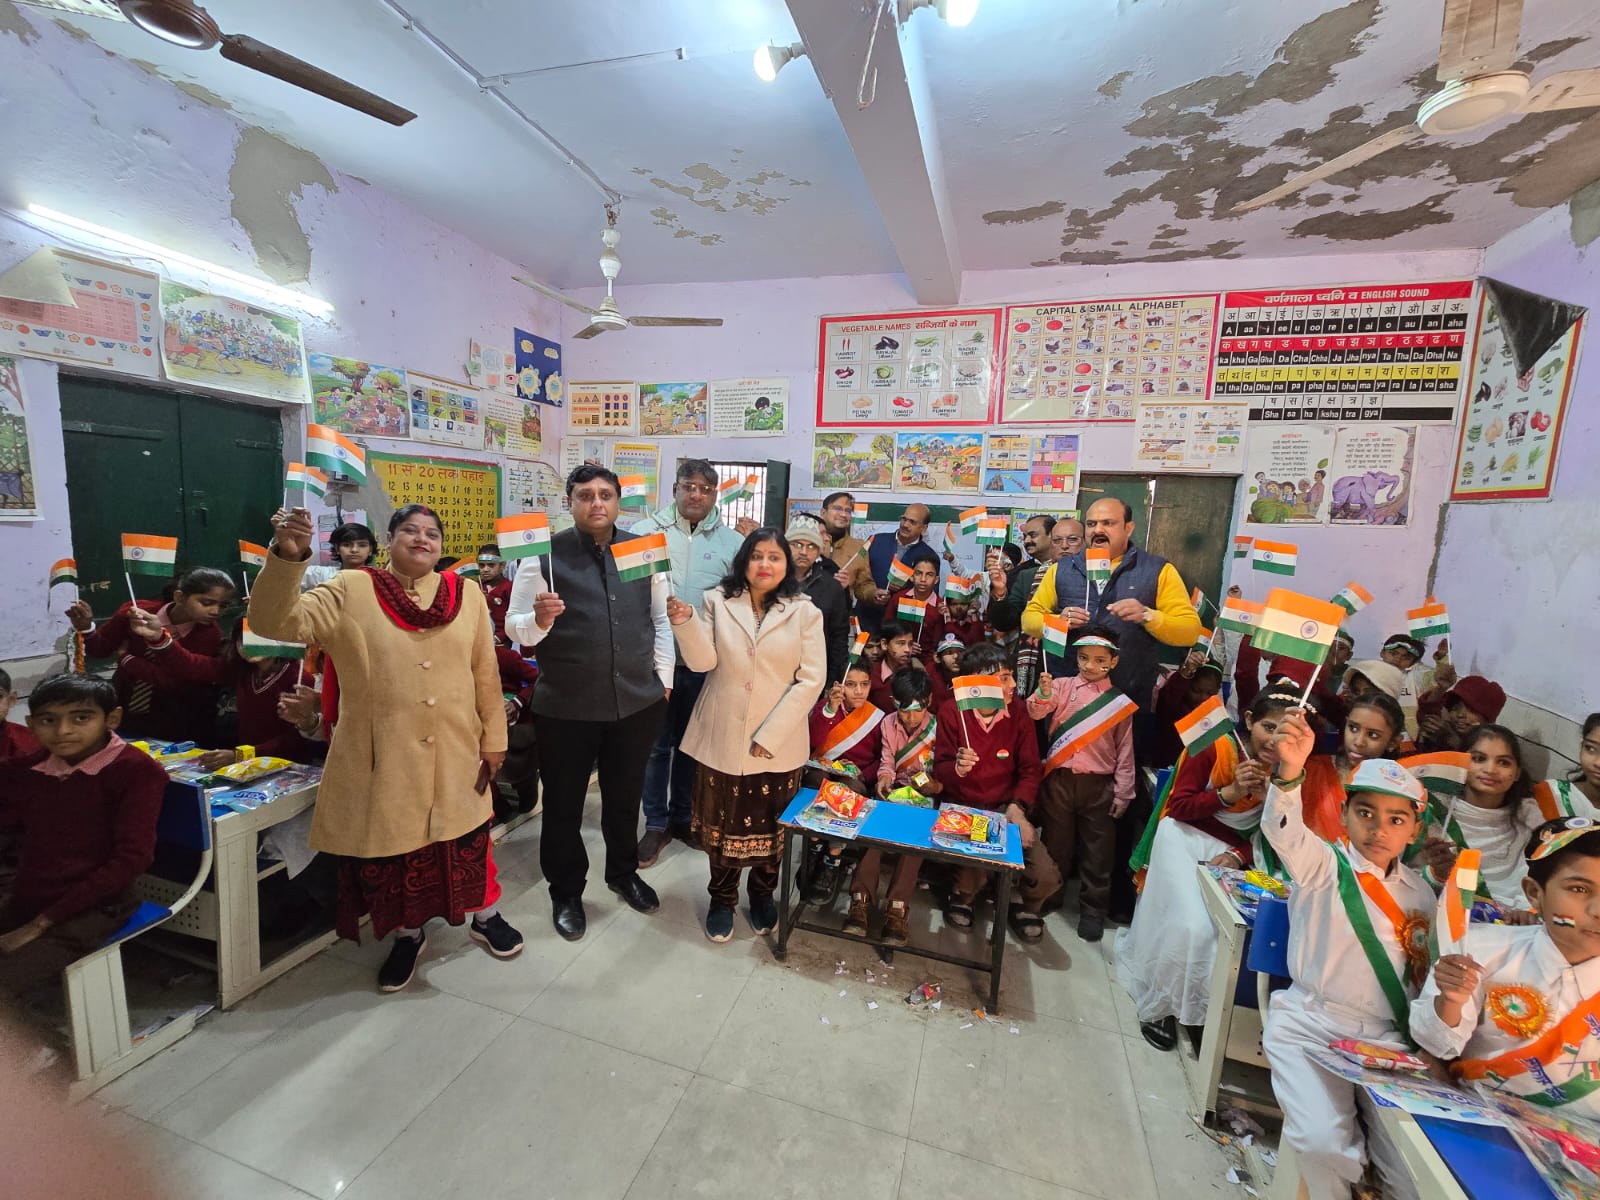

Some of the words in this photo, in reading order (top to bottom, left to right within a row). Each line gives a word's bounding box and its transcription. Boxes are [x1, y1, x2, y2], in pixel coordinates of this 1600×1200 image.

[1264, 292, 1313, 304] वर्णमाला
[1316, 290, 1346, 302] ध्वनि
[1361, 290, 1397, 299] ENGLISH
[1400, 288, 1430, 298] SOUND
[1036, 307, 1077, 316] CAPITAL
[1089, 304, 1123, 313] SMALL
[1128, 300, 1186, 310] ALPHABET
[1228, 312, 1236, 320] अ
[1244, 312, 1256, 320] आ
[1264, 312, 1272, 320] इ
[1279, 308, 1287, 320] ई
[1295, 310, 1304, 318] उ
[1350, 308, 1358, 318] ए
[1365, 304, 1373, 318] ऐ
[1384, 303, 1396, 315] ओ
[841, 324, 884, 333] VEGETABLE
[885, 322, 911, 331] NAMES
[949, 320, 958, 328] के
[1226, 326, 1232, 334] A
[1448, 319, 1463, 328] aha
[1222, 342, 1231, 350] क
[1237, 340, 1247, 349] ख
[1250, 340, 1258, 349] ग
[1336, 338, 1346, 346] ज
[1385, 336, 1394, 346] ट
[1402, 336, 1410, 345] ठ
[1278, 355, 1289, 363] Da
[1292, 354, 1308, 362] Cha
[1332, 354, 1342, 362] Ja
[1426, 352, 1442, 360] Dha
[1446, 351, 1458, 359] Na
[1396, 367, 1404, 376] र
[1410, 367, 1420, 376] ल
[1440, 366, 1451, 376] श
[1256, 384, 1270, 392] Dha
[1308, 382, 1323, 390] pha
[1326, 382, 1336, 390] ba
[1342, 382, 1356, 390] bha
[1376, 382, 1386, 390] ya
[1439, 381, 1454, 389] sha
[1264, 409, 1279, 418] Sha
[1320, 410, 1339, 418] ksha
[1364, 409, 1379, 418] gya
[388, 463, 397, 476] 11
[401, 462, 414, 476] से
[418, 466, 435, 478] 20
[438, 468, 458, 480] तक
[388, 481, 395, 490] 12
[403, 482, 410, 490] 13
[416, 482, 424, 491] 14
[428, 484, 435, 492] 15
[453, 486, 460, 494] 17
[416, 496, 424, 504] 28
[440, 496, 448, 505] 32
[452, 498, 460, 506] 34
[464, 498, 471, 506] 36
[440, 510, 449, 518] 48
[452, 510, 460, 518] 51
[464, 510, 472, 518] 54
[476, 510, 483, 518] 57
[466, 522, 473, 530] 72
[452, 546, 462, 554] 102
